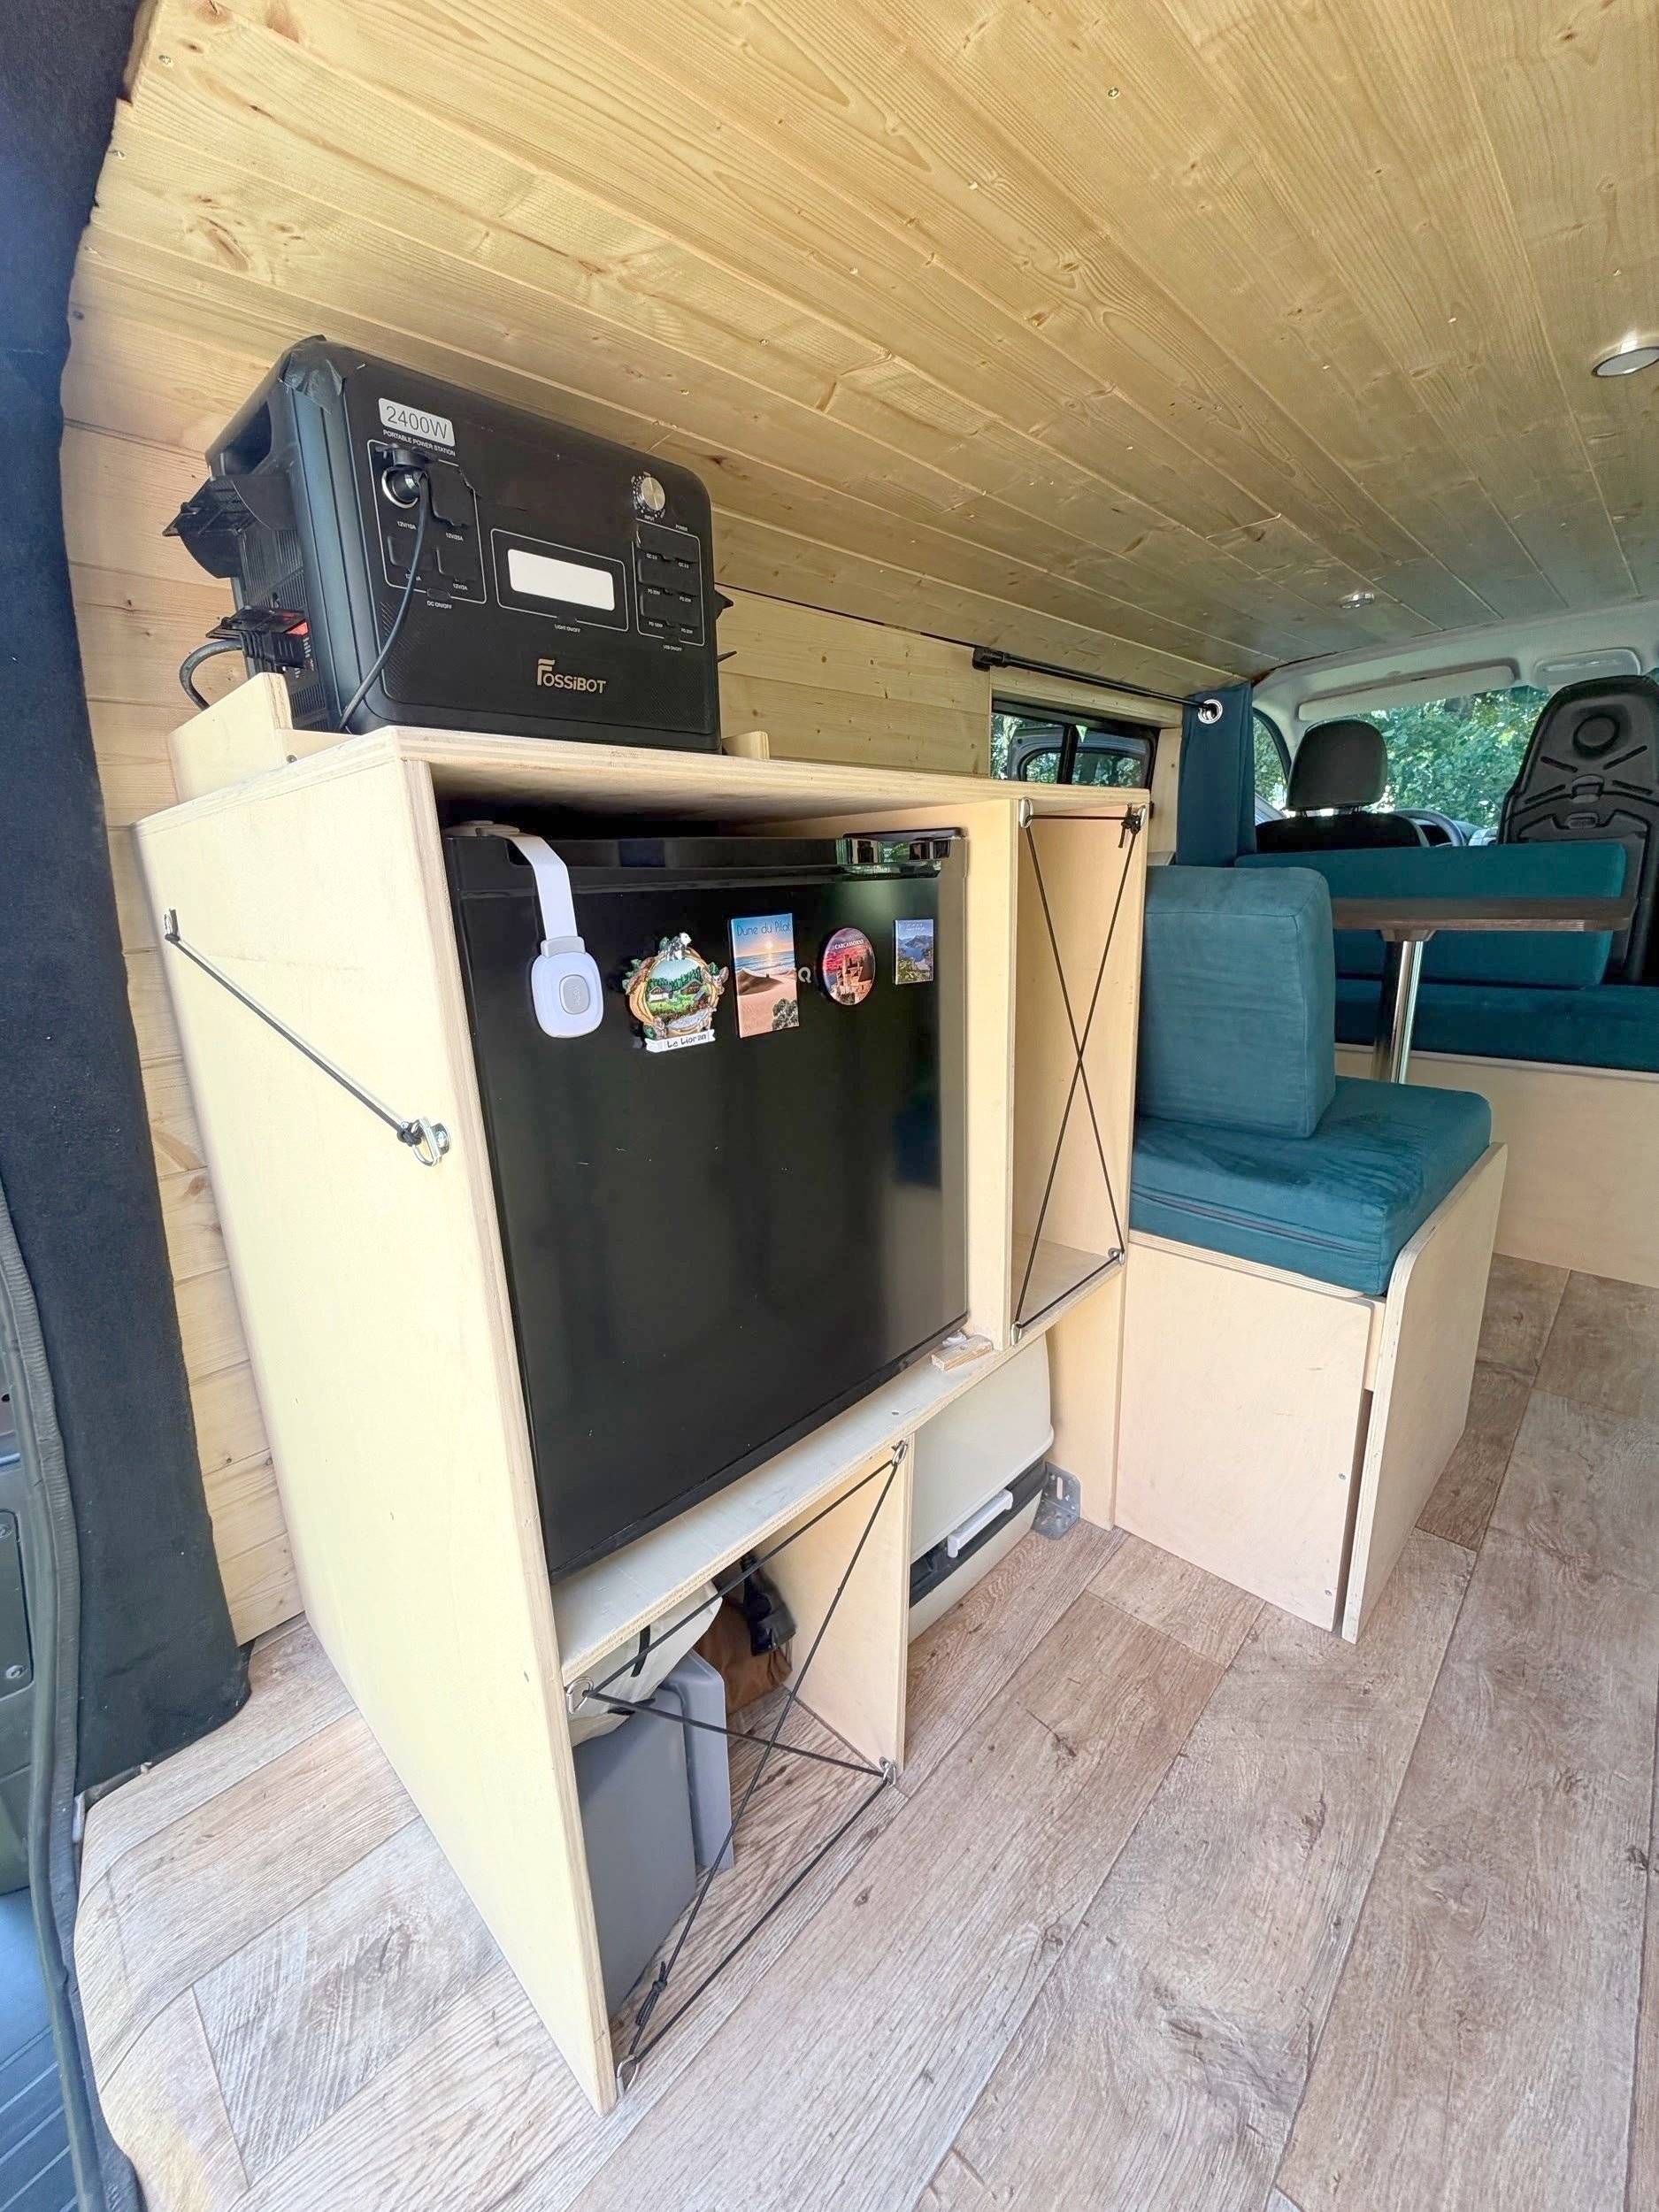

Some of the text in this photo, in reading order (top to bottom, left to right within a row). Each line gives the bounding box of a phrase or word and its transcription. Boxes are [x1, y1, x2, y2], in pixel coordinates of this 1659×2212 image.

[386, 405, 447, 440] 2400W
[382, 429, 456, 457] PORTABLE POWER STATION
[396, 520, 417, 530] 12V/10A
[736, 919, 791, 936] Dune du Pilat
[666, 1033, 707, 1048] Le Lioran
